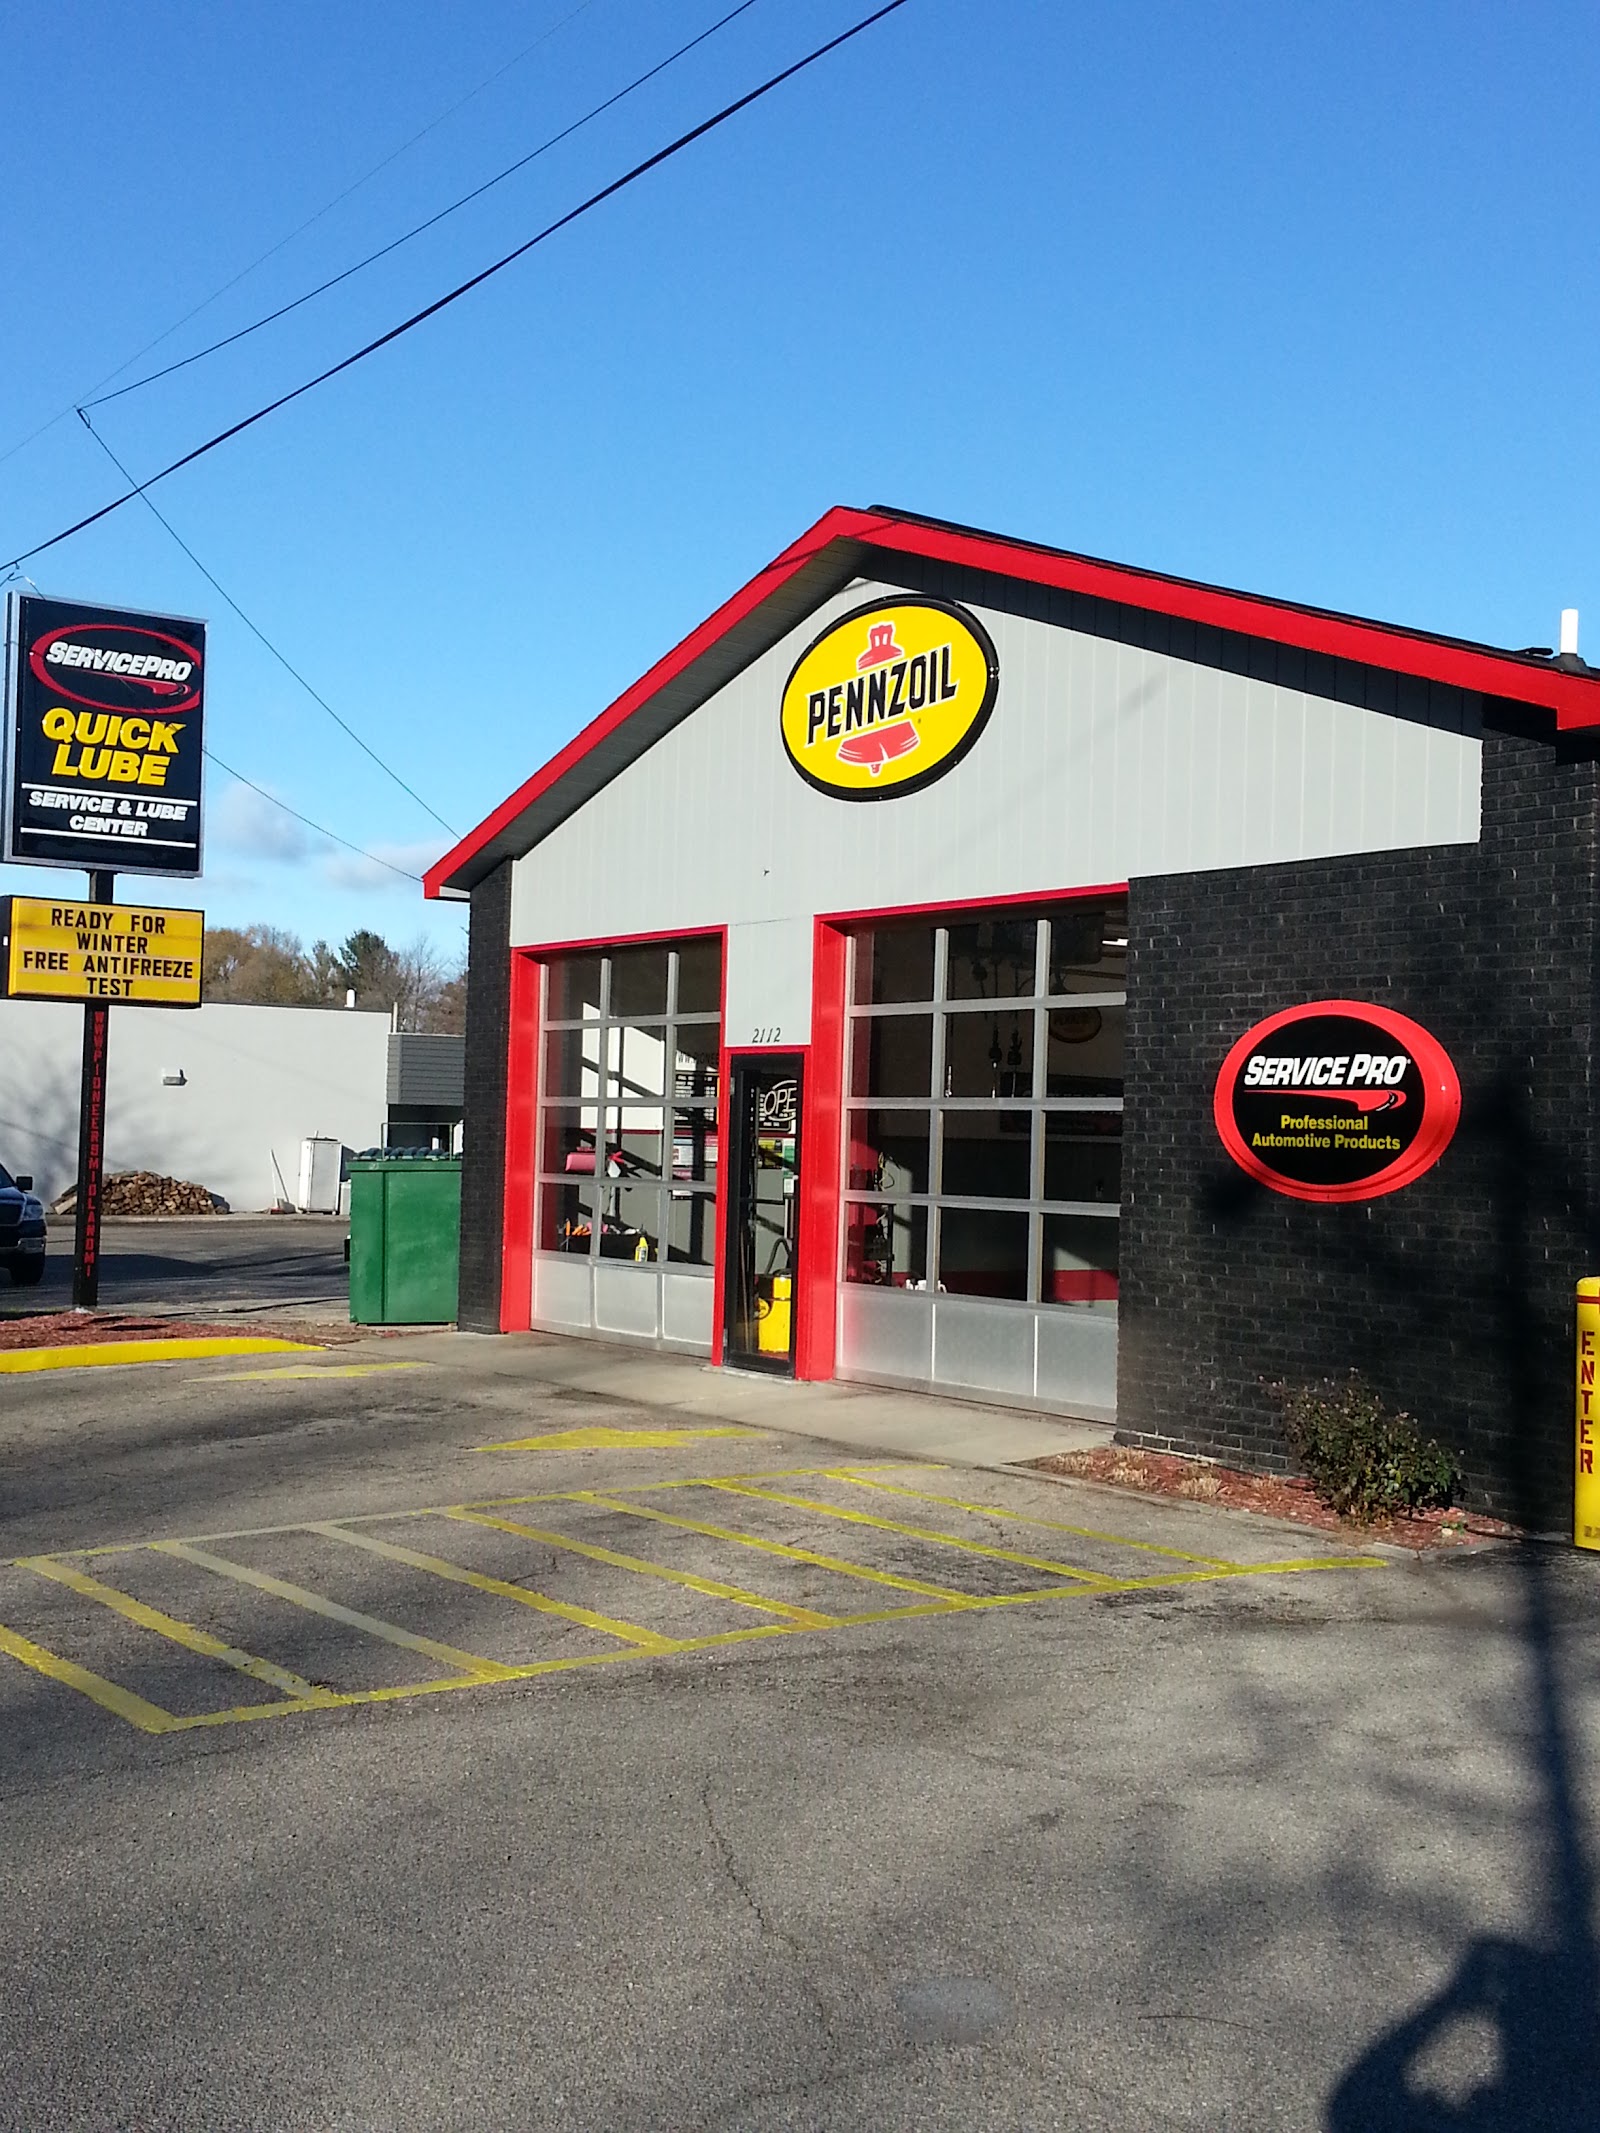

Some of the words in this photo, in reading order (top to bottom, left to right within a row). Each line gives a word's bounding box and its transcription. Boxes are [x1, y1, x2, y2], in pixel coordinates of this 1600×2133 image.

[807, 645, 959, 746] PENNZOIL
[42, 707, 186, 754] QUICK
[52, 744, 171, 786] LUBE
[29, 791, 113, 814] SERVICE
[117, 800, 132, 816] &
[138, 802, 188, 821] LUBE
[69, 817, 148, 837] CENTER
[51, 908, 114, 930] READY
[131, 914, 165, 934] FOR
[77, 932, 148, 954] WINTER
[24, 951, 69, 971] FREE
[83, 955, 193, 979] ANTIFREEZE
[87, 976, 134, 996] TEST
[752, 1027, 781, 1044] 2112
[764, 1087, 797, 1115] OPE
[1280, 1114, 1369, 1130] Professional
[1252, 1133, 1331, 1149] Automotive
[1334, 1134, 1401, 1150] Products
[1580, 1330, 1595, 1474] ENTER
